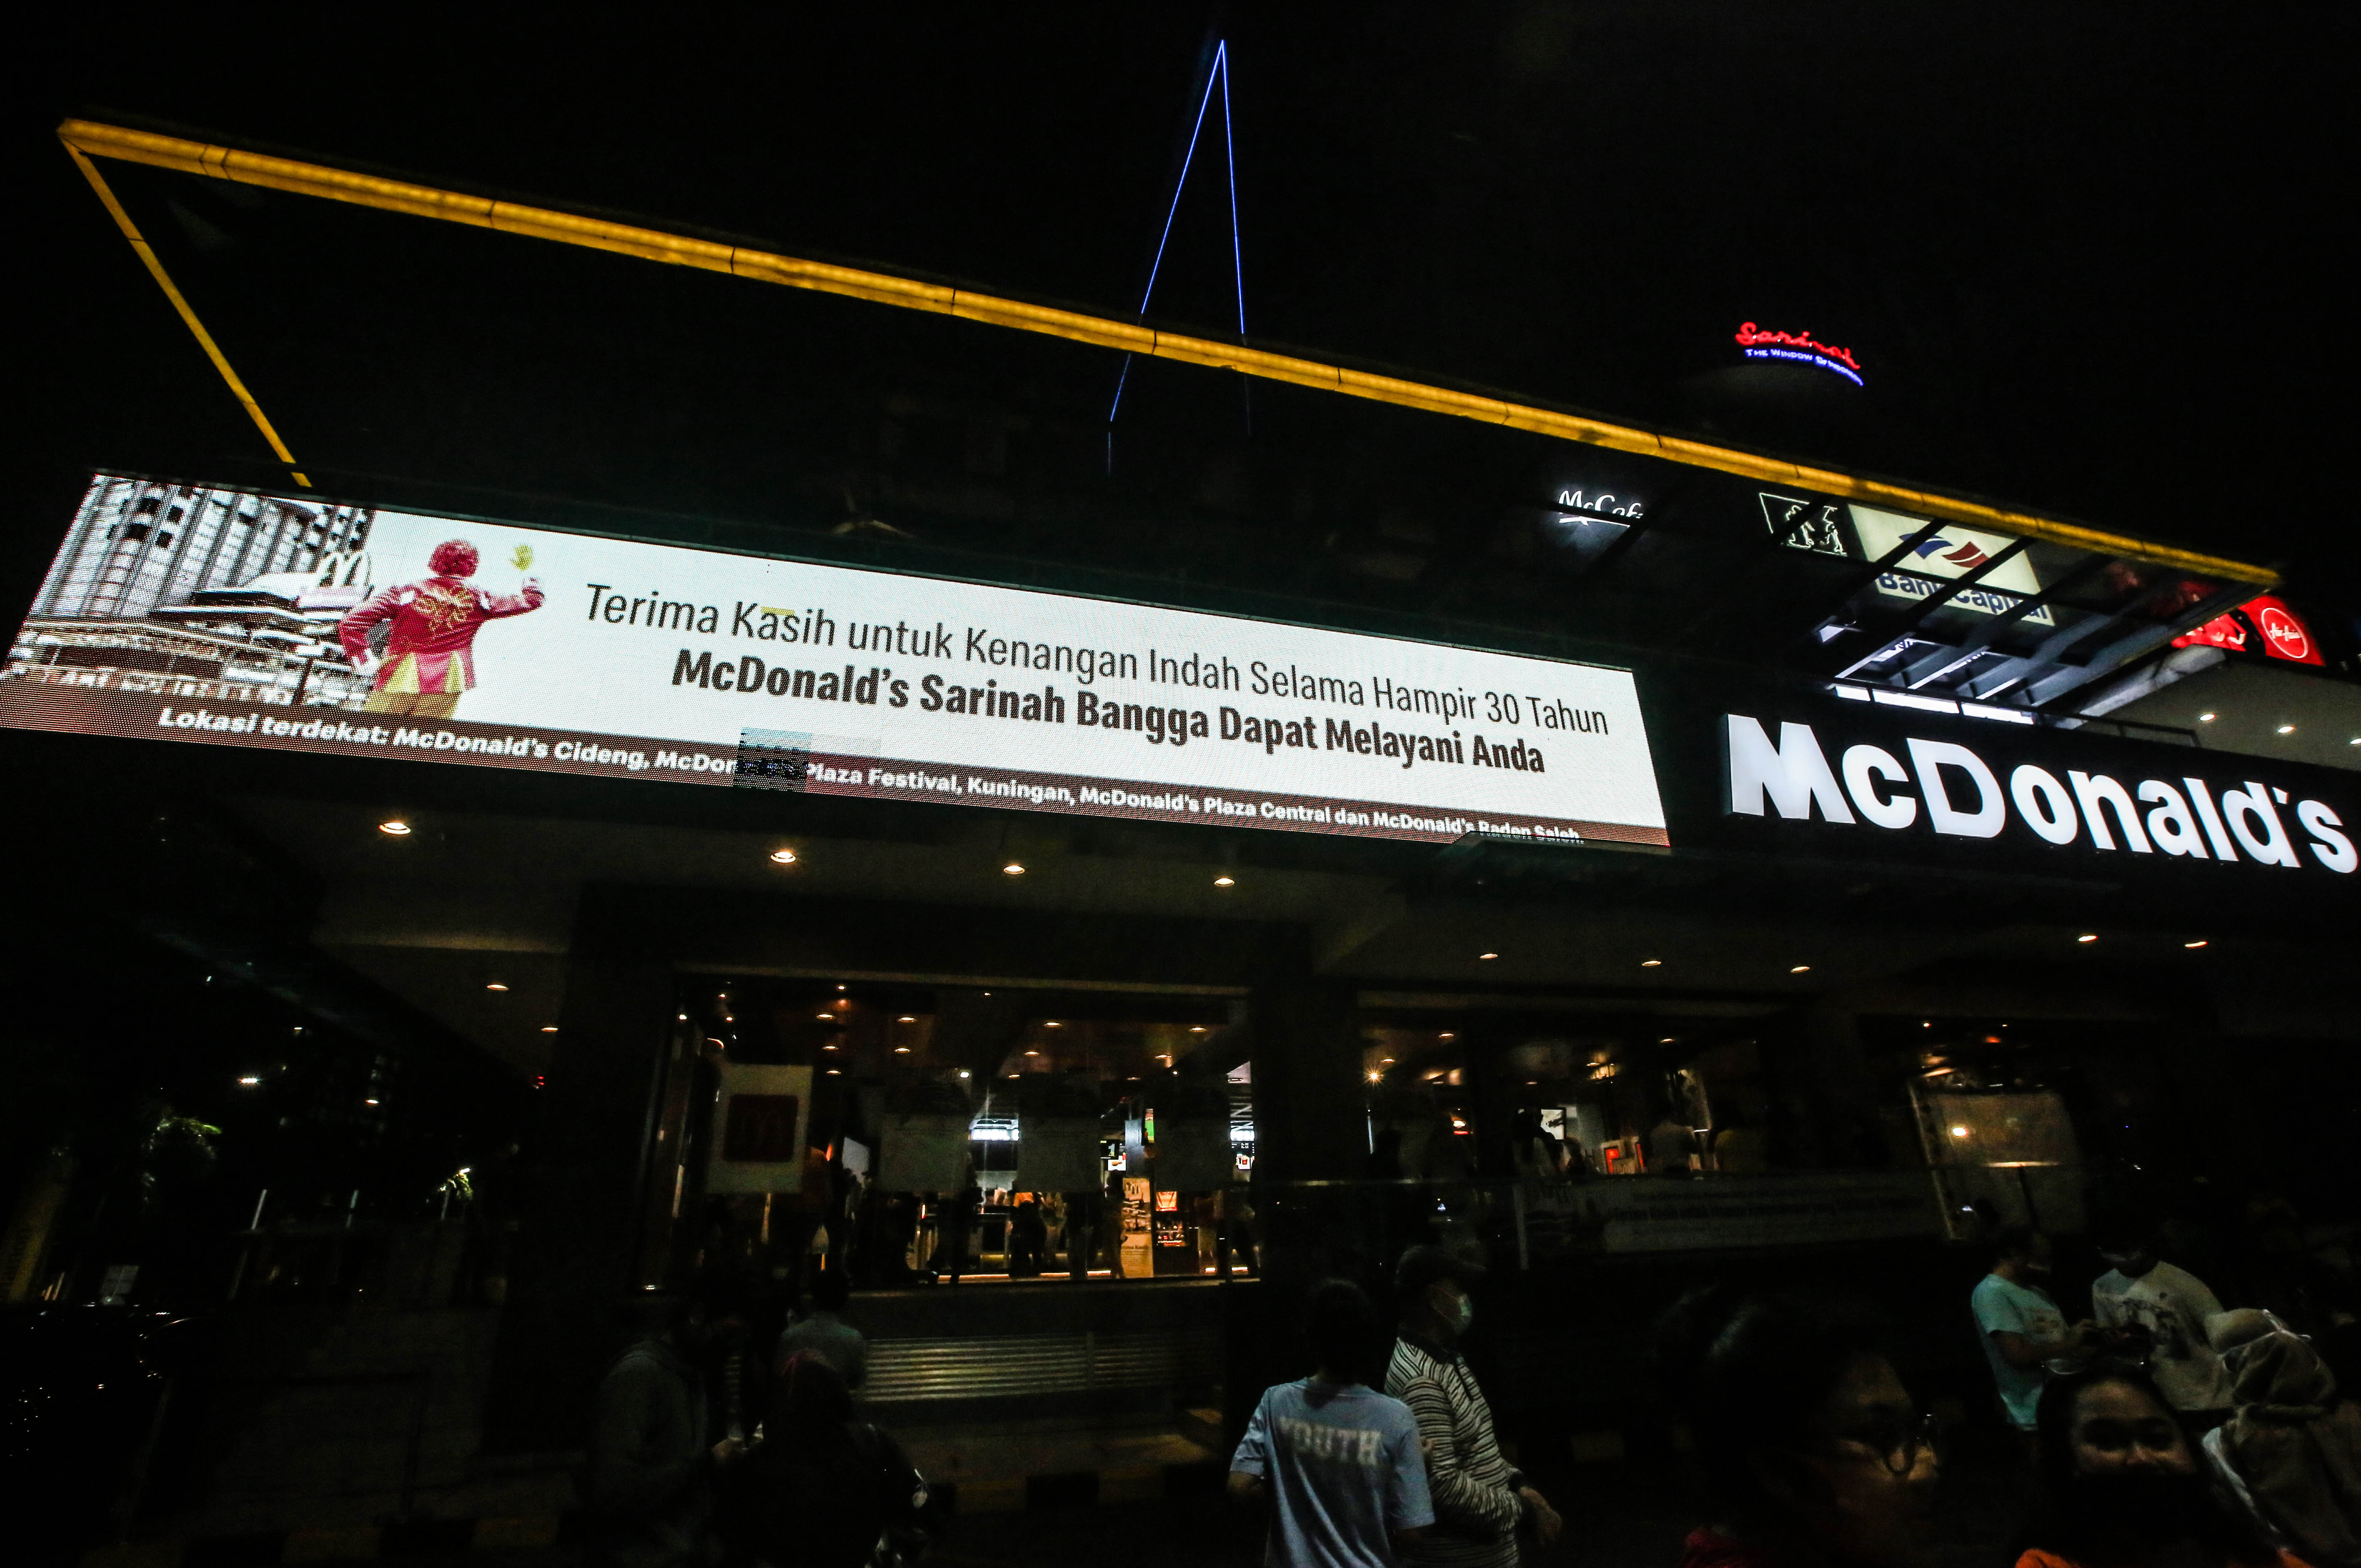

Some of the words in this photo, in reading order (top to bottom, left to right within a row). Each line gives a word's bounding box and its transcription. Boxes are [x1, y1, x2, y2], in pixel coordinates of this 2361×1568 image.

[1745, 349, 1768, 357] THE
[1770, 349, 1813, 361] WINDOW
[1558, 490, 1643, 519] McCaf
[587, 583, 718, 633] Terima
[732, 601, 835, 645] Kasih
[848, 620, 953, 658] untuk
[966, 628, 1138, 684] Kenangan
[1150, 648, 1240, 692] Indah
[1251, 661, 1364, 706] Selama
[1374, 676, 1476, 725] Hampir
[1485, 692, 1520, 725] 30
[1525, 695, 1608, 735] Tahun
[673, 650, 908, 707] McDonald's
[920, 674, 1064, 723] Sarinah
[1077, 691, 1209, 746] Bangga
[1220, 706, 1316, 754] Dapat
[1326, 719, 1464, 769] Melayani
[1473, 734, 1545, 773] Anda
[158, 707, 258, 733] Lokasi
[393, 727, 548, 758] McDonald's
[554, 741, 651, 771] Cideng,
[868, 767, 962, 795] Festival,
[967, 777, 1076, 806] Kuningan,
[1081, 787, 1200, 813] McDonald's
[1204, 797, 1256, 817] Plaza
[1260, 802, 1331, 824] Central
[1335, 809, 1370, 826] dan
[1727, 713, 2359, 874] McDonald's
[1278, 1416, 1382, 1466] YOUTH
